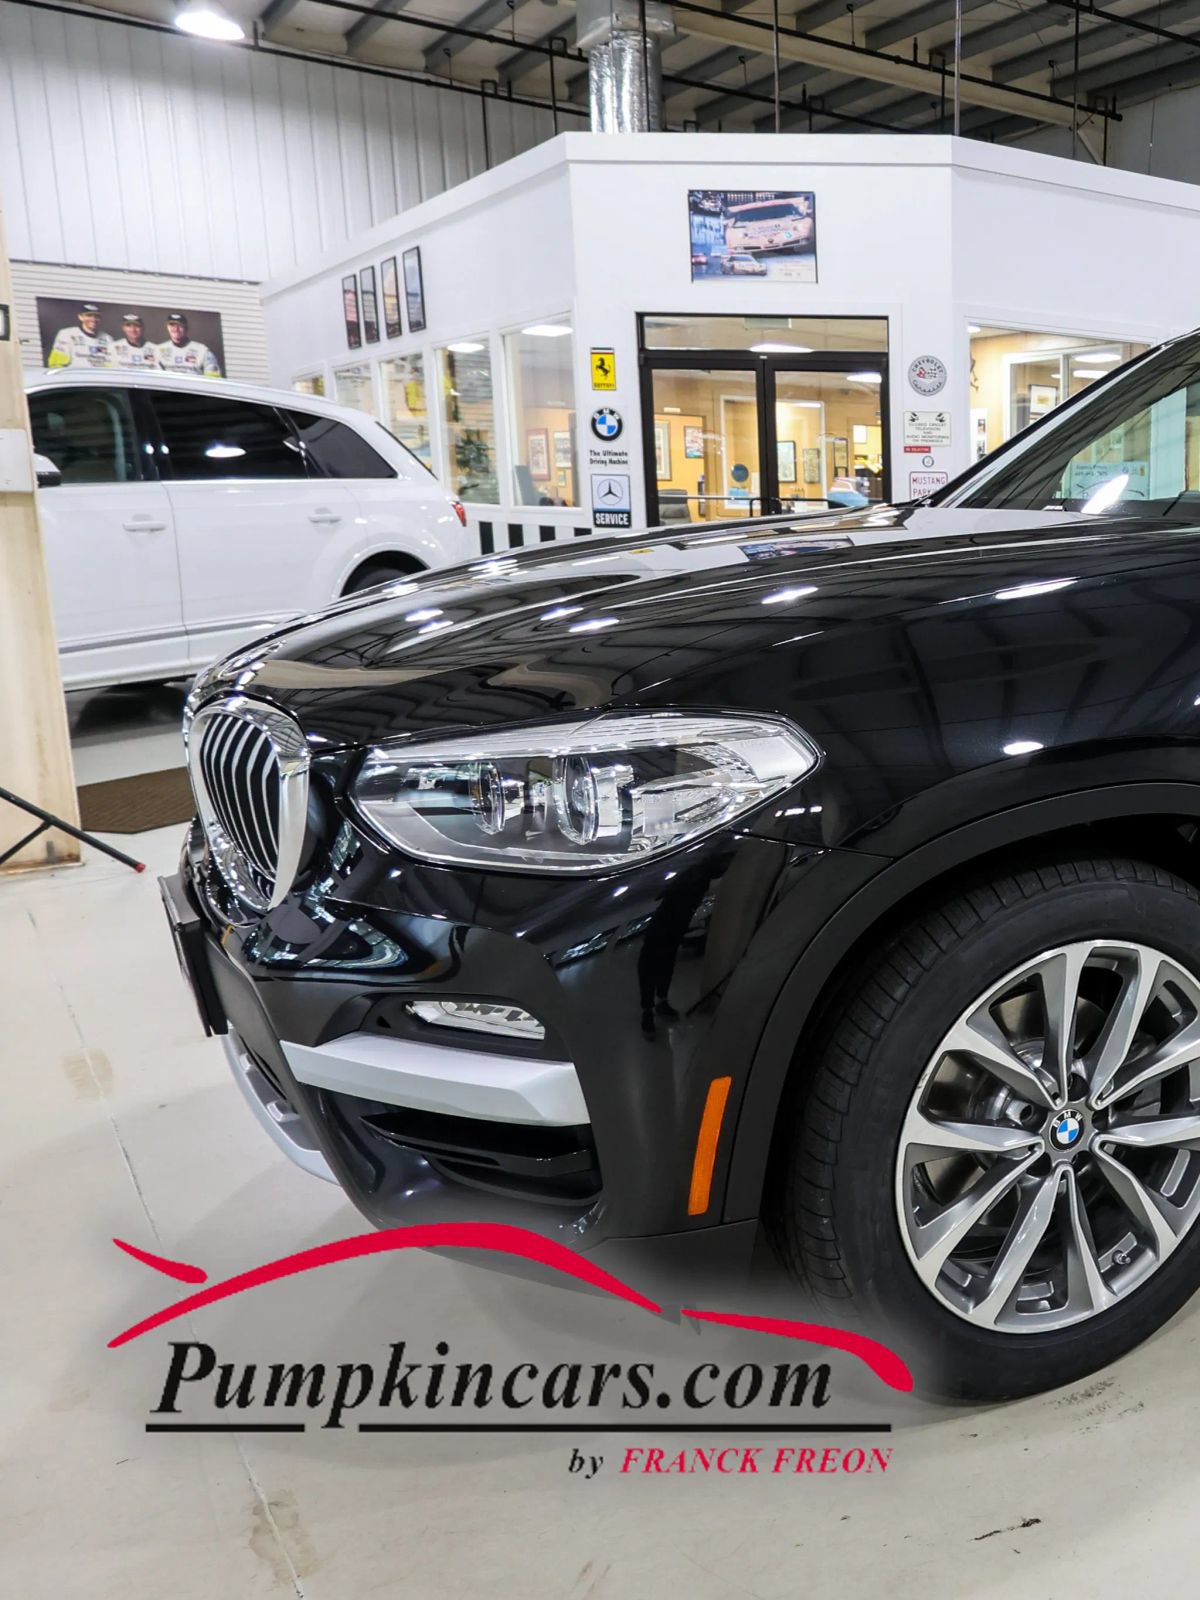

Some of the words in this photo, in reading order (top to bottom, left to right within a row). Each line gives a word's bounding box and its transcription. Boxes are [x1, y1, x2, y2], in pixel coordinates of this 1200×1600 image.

[911, 357, 944, 373] CHEVROLET
[589, 449, 600, 457] The
[589, 458, 607, 467] Driving
[912, 476, 946, 485] MUSTANG
[595, 512, 629, 526] SERVICE
[1052, 1111, 1083, 1128] BMW
